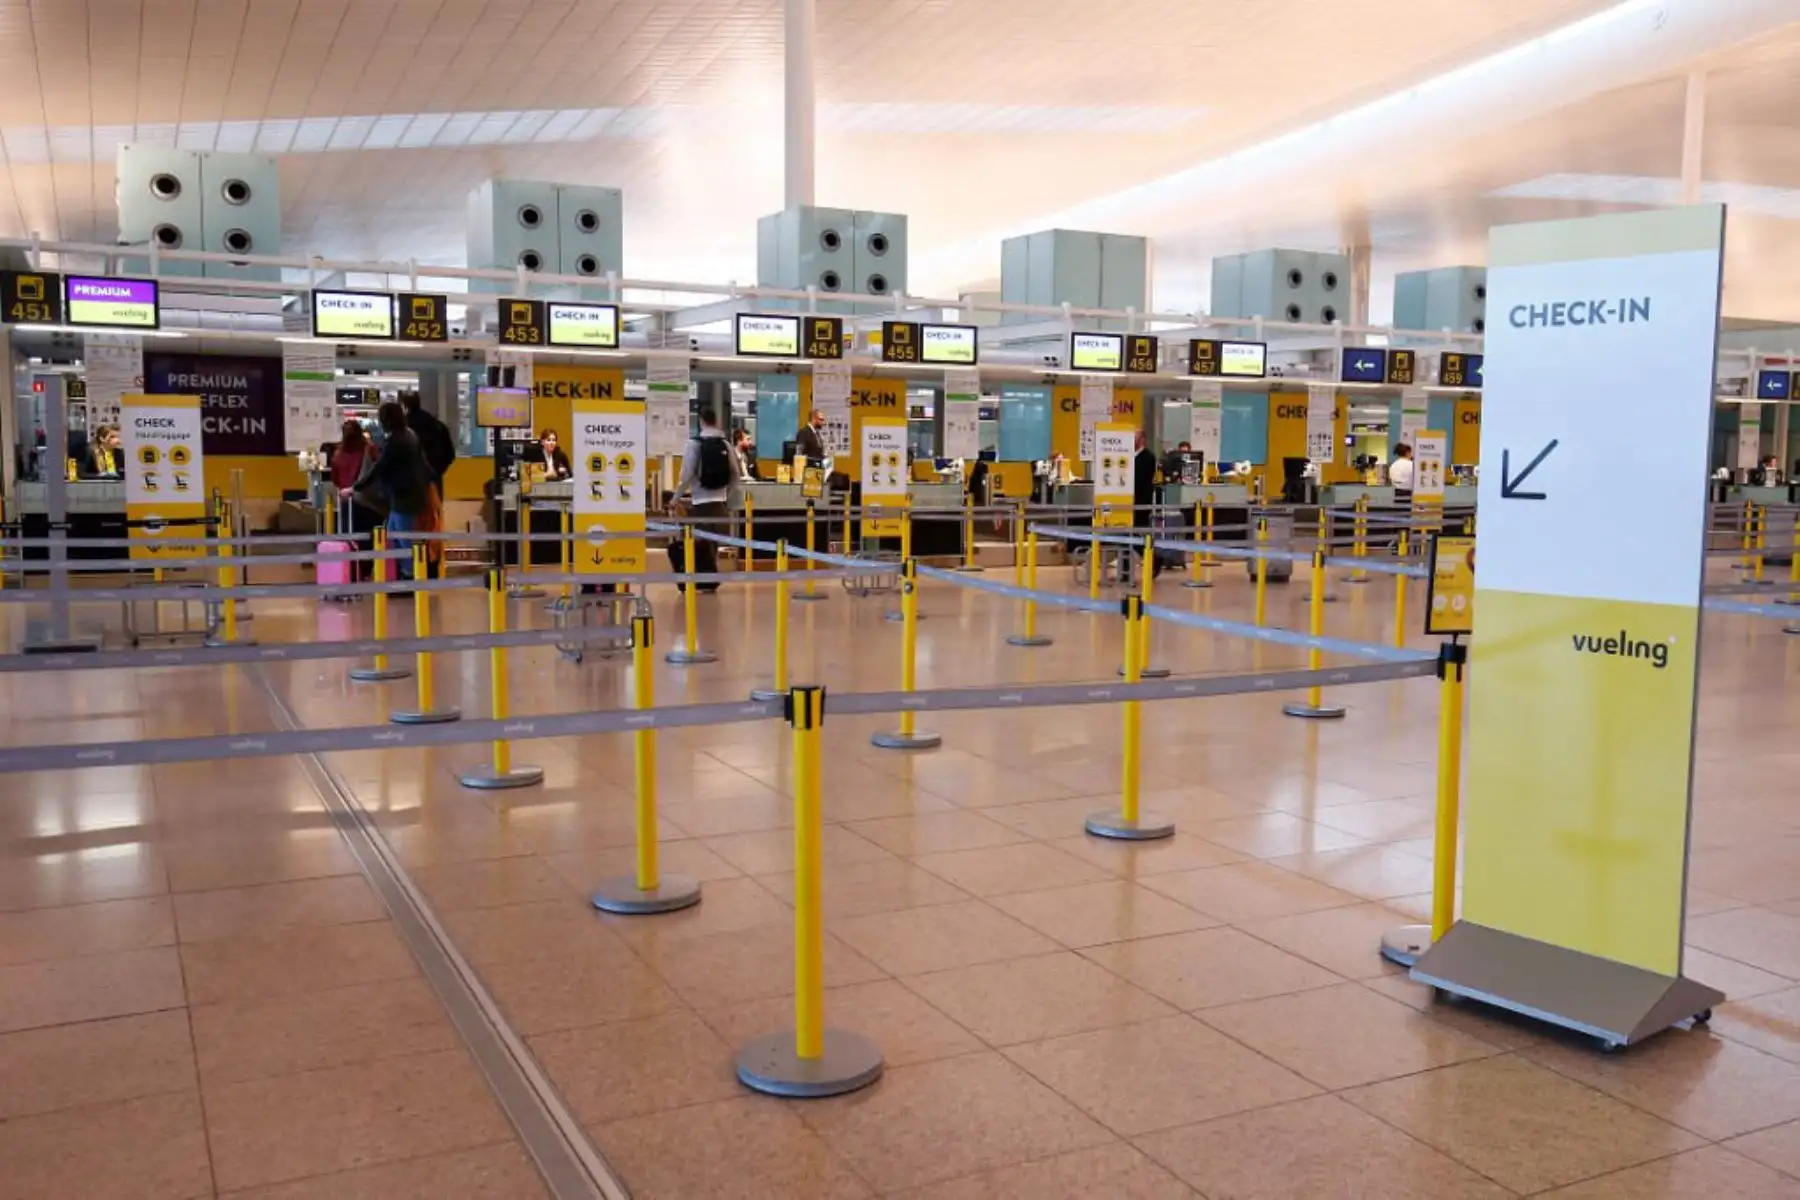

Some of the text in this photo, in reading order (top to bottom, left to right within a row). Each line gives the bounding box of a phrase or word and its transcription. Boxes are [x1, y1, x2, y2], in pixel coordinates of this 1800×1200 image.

[74, 284, 132, 297] PREMIUM
[11, 302, 52, 321] 451
[1509, 296, 1651, 328] CHECK-IN
[406, 322, 442, 338] 452
[504, 326, 540, 342] 453
[808, 341, 838, 357] 454
[887, 345, 914, 360] 455
[1129, 356, 1155, 371] 456
[1193, 360, 1216, 374] 457
[168, 372, 248, 389] PREMIUM
[532, 381, 613, 398] HECK-IN
[200, 393, 248, 408] EFLEX
[134, 417, 176, 428] CHECK
[203, 416, 267, 434] CK-IN
[584, 424, 622, 434] CHECK
[1572, 629, 1669, 669] vueling
